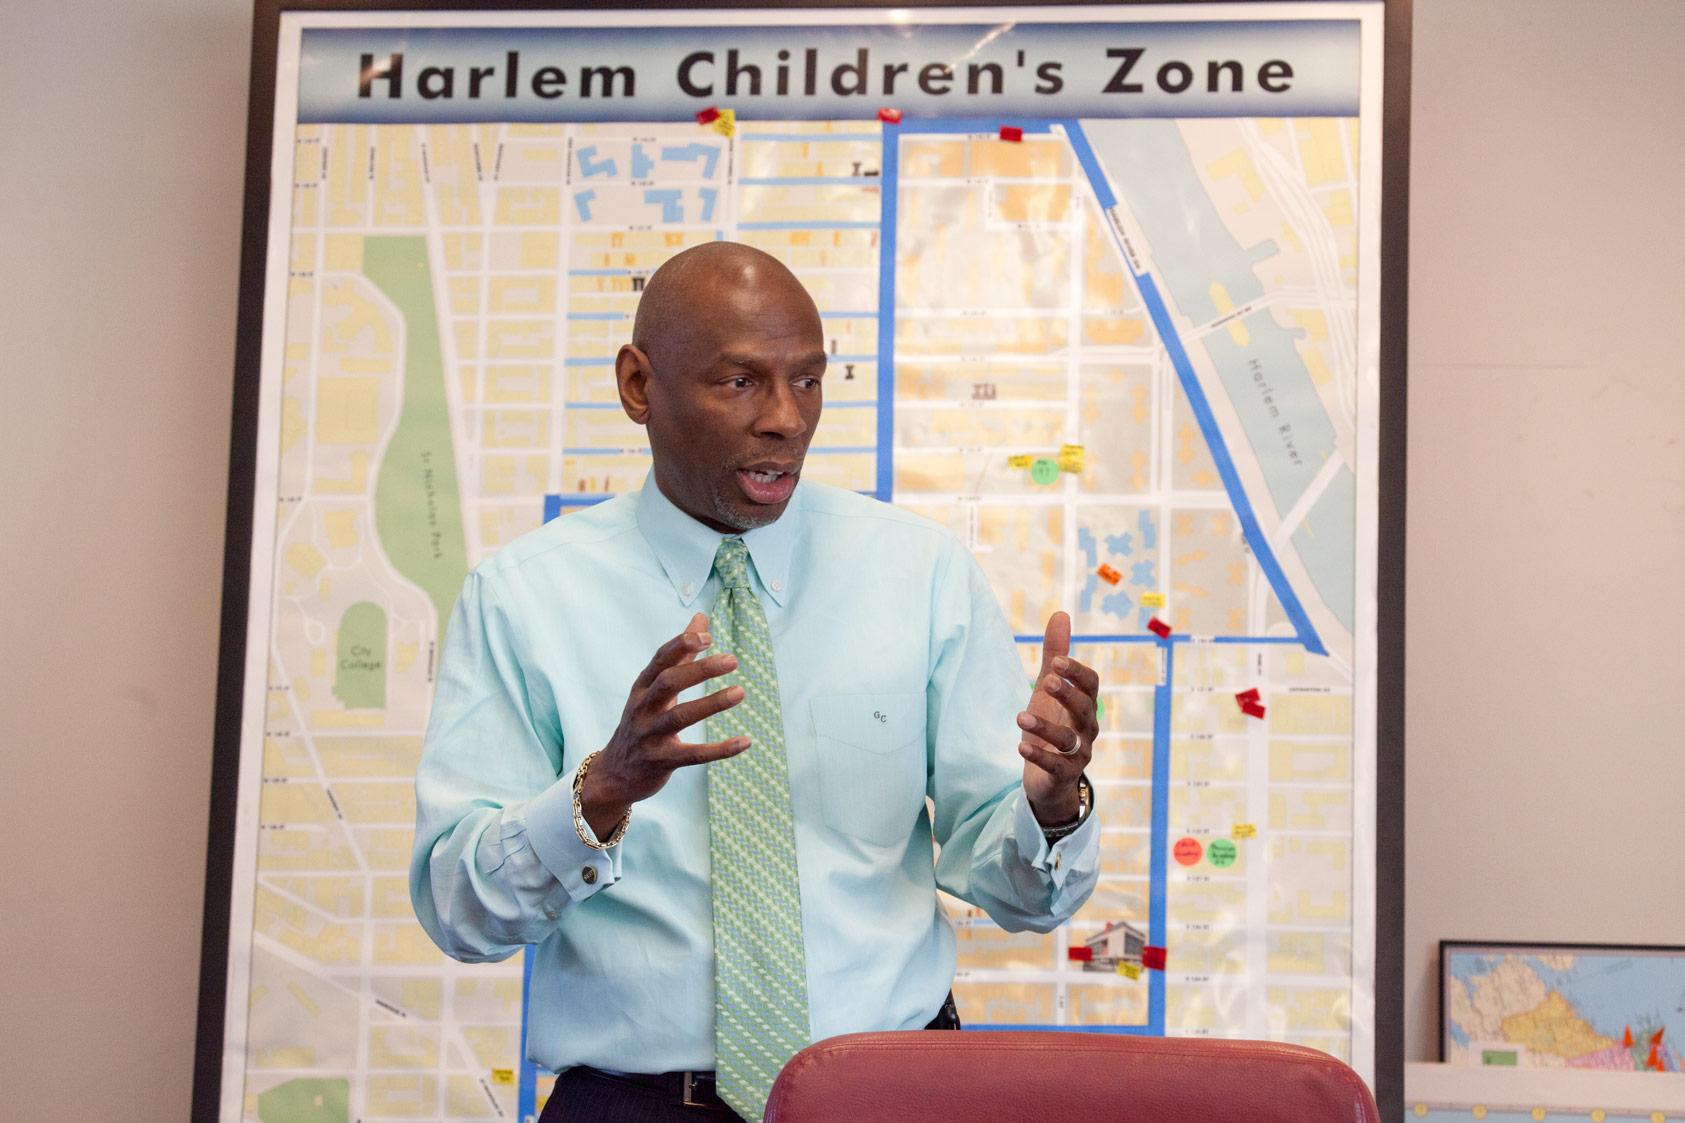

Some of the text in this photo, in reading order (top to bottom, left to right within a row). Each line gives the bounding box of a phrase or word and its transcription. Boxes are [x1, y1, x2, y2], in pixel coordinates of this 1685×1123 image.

[358, 47, 1295, 100] Harlem Children's Zone
[1248, 359, 1303, 464] Harlem River
[340, 659, 382, 672] College
[351, 646, 373, 658] City
